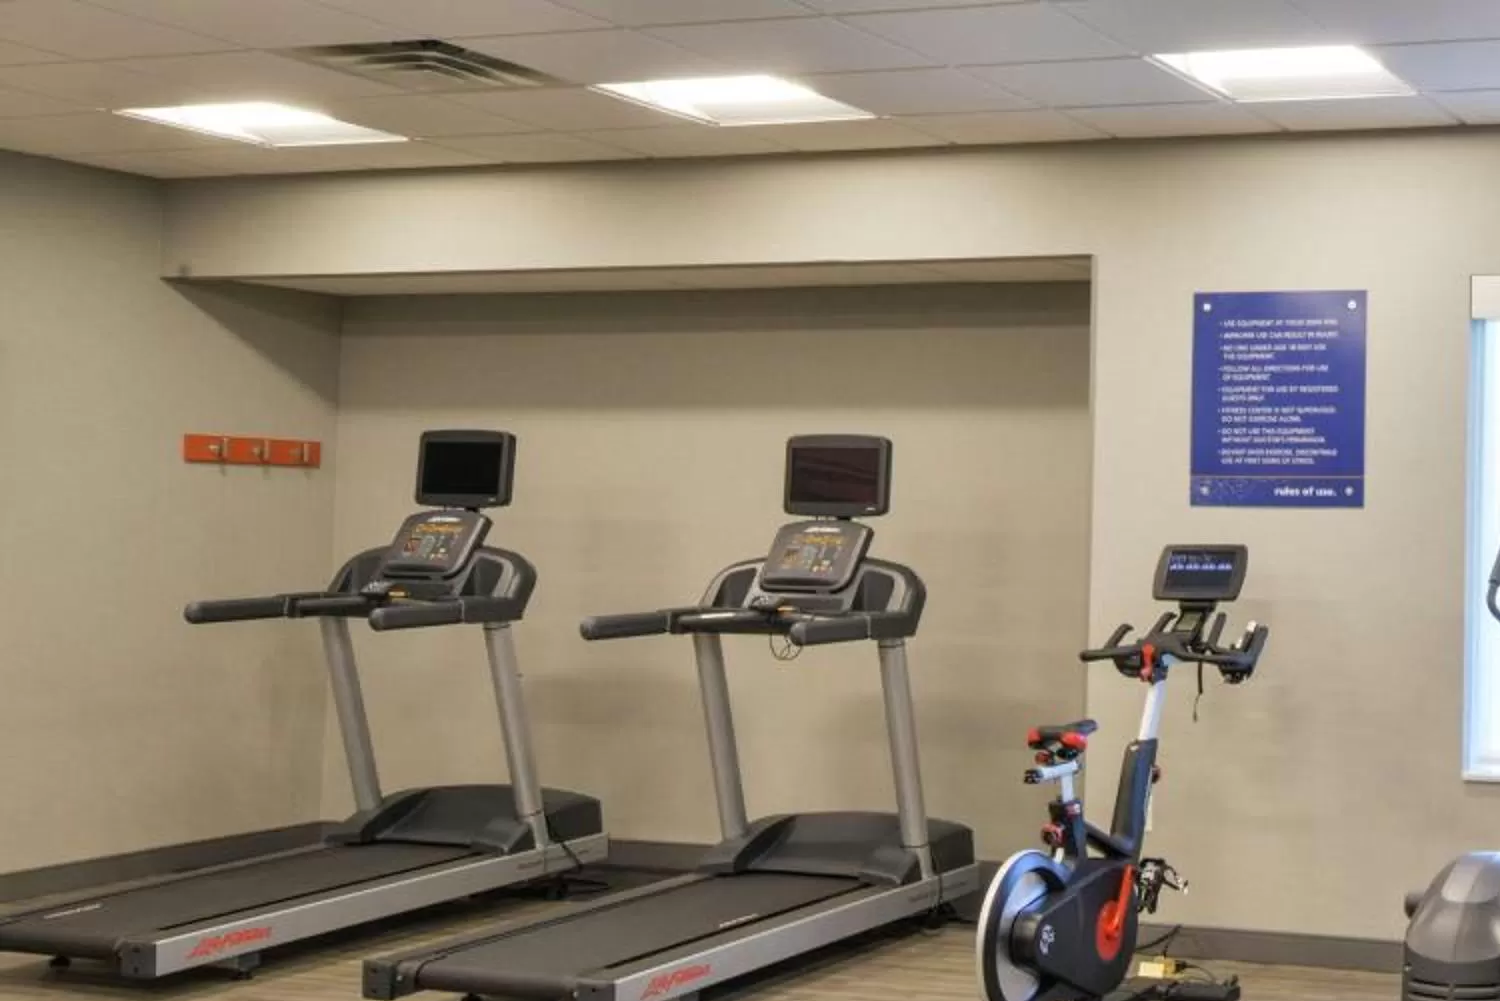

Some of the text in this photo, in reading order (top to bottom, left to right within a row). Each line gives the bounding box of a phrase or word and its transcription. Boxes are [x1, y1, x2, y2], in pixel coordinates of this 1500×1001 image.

[1273, 486, 1337, 497] rules of use.
